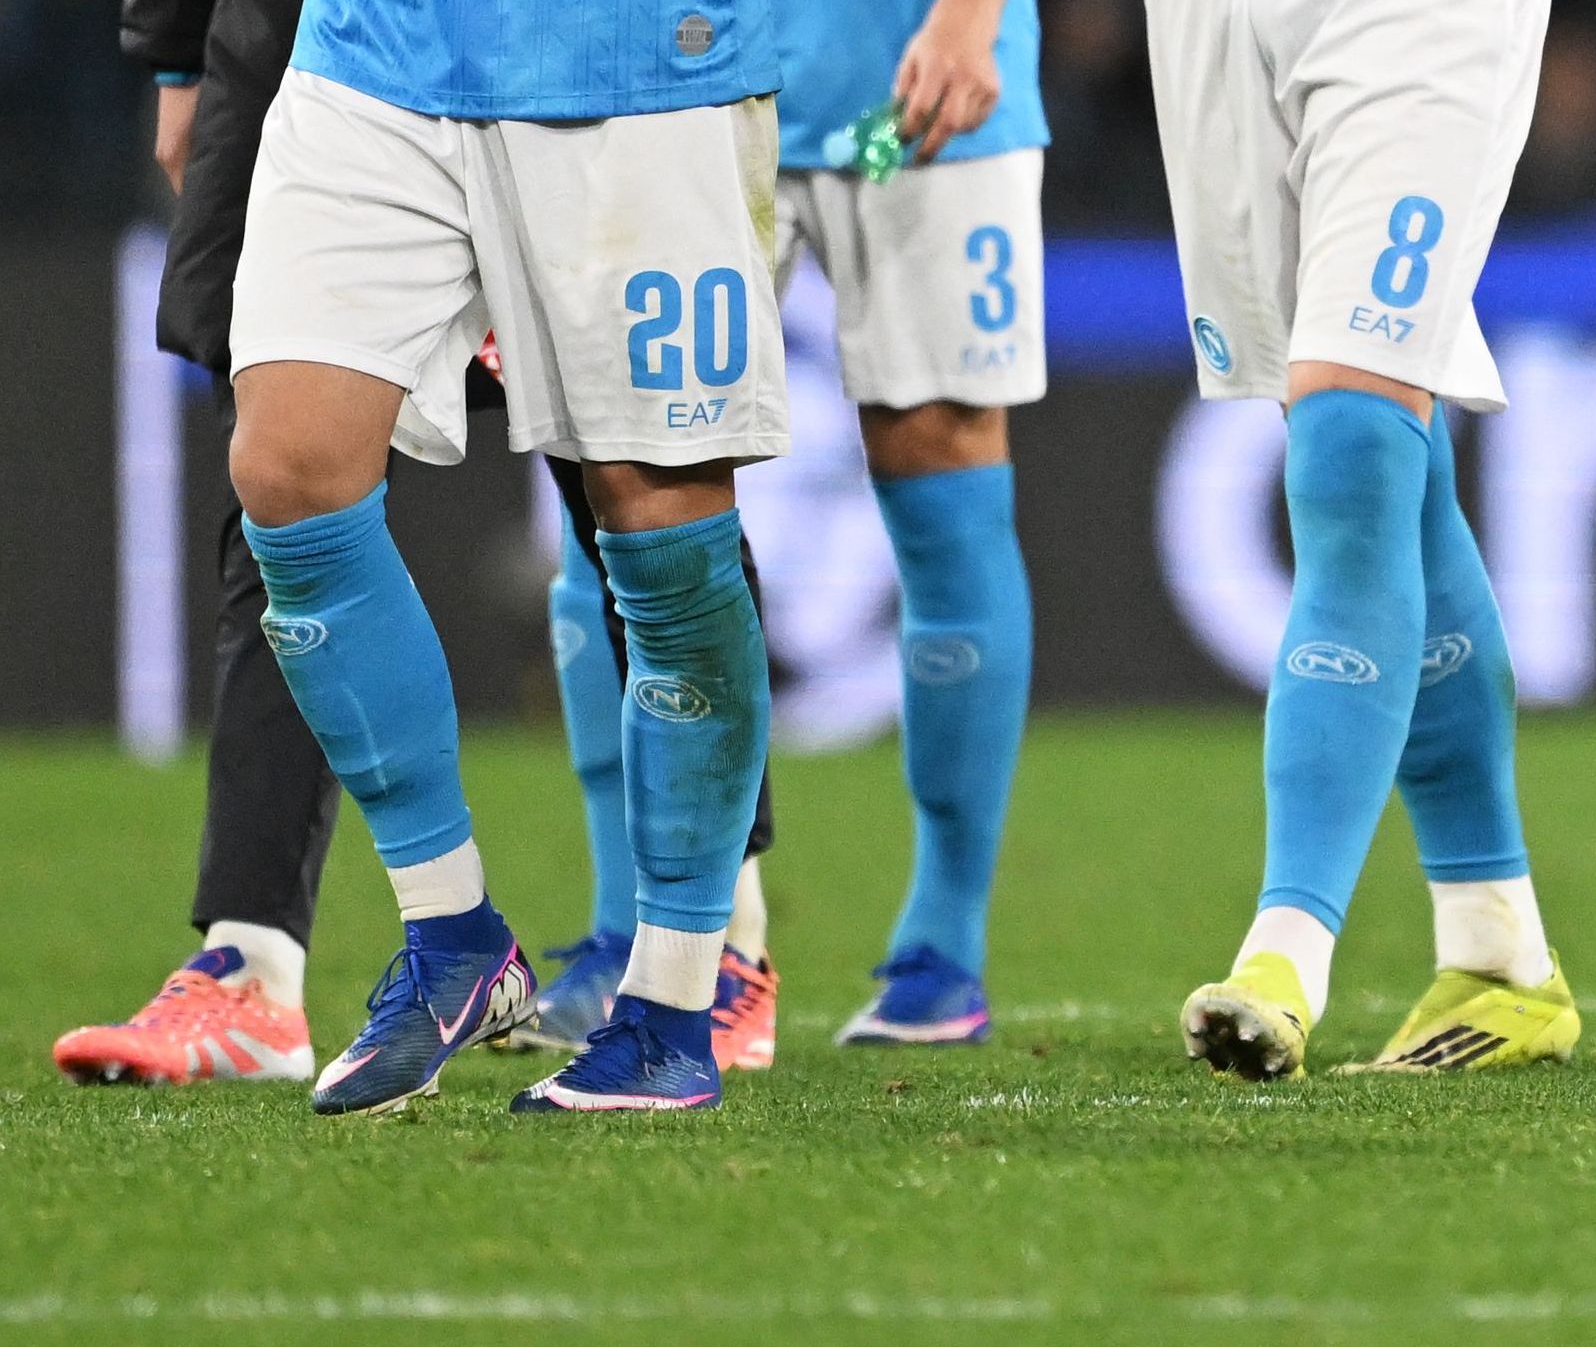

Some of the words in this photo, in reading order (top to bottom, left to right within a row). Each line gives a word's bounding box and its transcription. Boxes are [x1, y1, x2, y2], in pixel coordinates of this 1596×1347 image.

[966, 225, 1017, 332] 3
[1372, 195, 1444, 309] 8
[625, 267, 748, 391] 20
[1349, 305, 1417, 343] EA7
[667, 398, 727, 429] EA7
